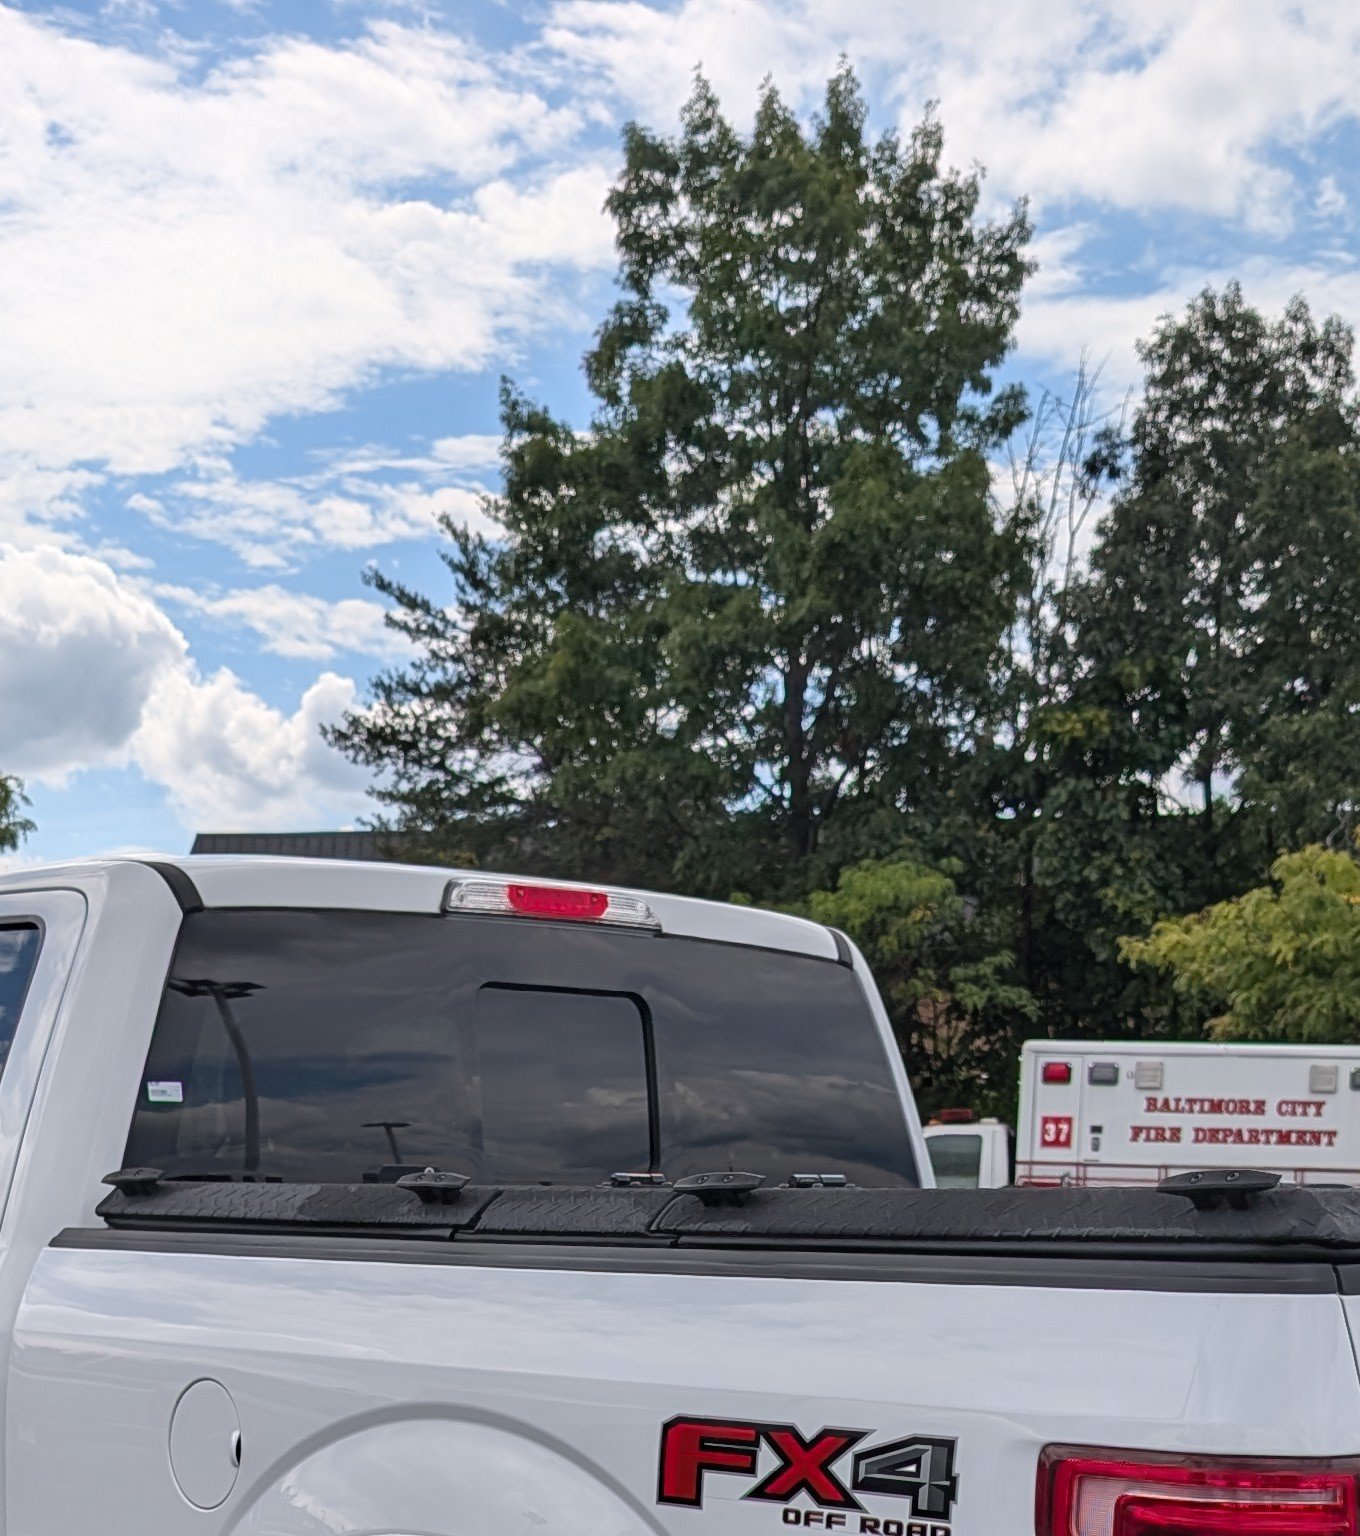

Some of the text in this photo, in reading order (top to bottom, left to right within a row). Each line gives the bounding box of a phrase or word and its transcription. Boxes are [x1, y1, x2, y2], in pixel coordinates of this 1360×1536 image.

[1144, 1096, 1326, 1119] BALTIMORE CITY
[1042, 1122, 1071, 1145] 37
[1129, 1125, 1338, 1148] FIRE DEPARTMENT
[656, 1413, 960, 1523] FX4
[782, 1507, 847, 1530] OFF
